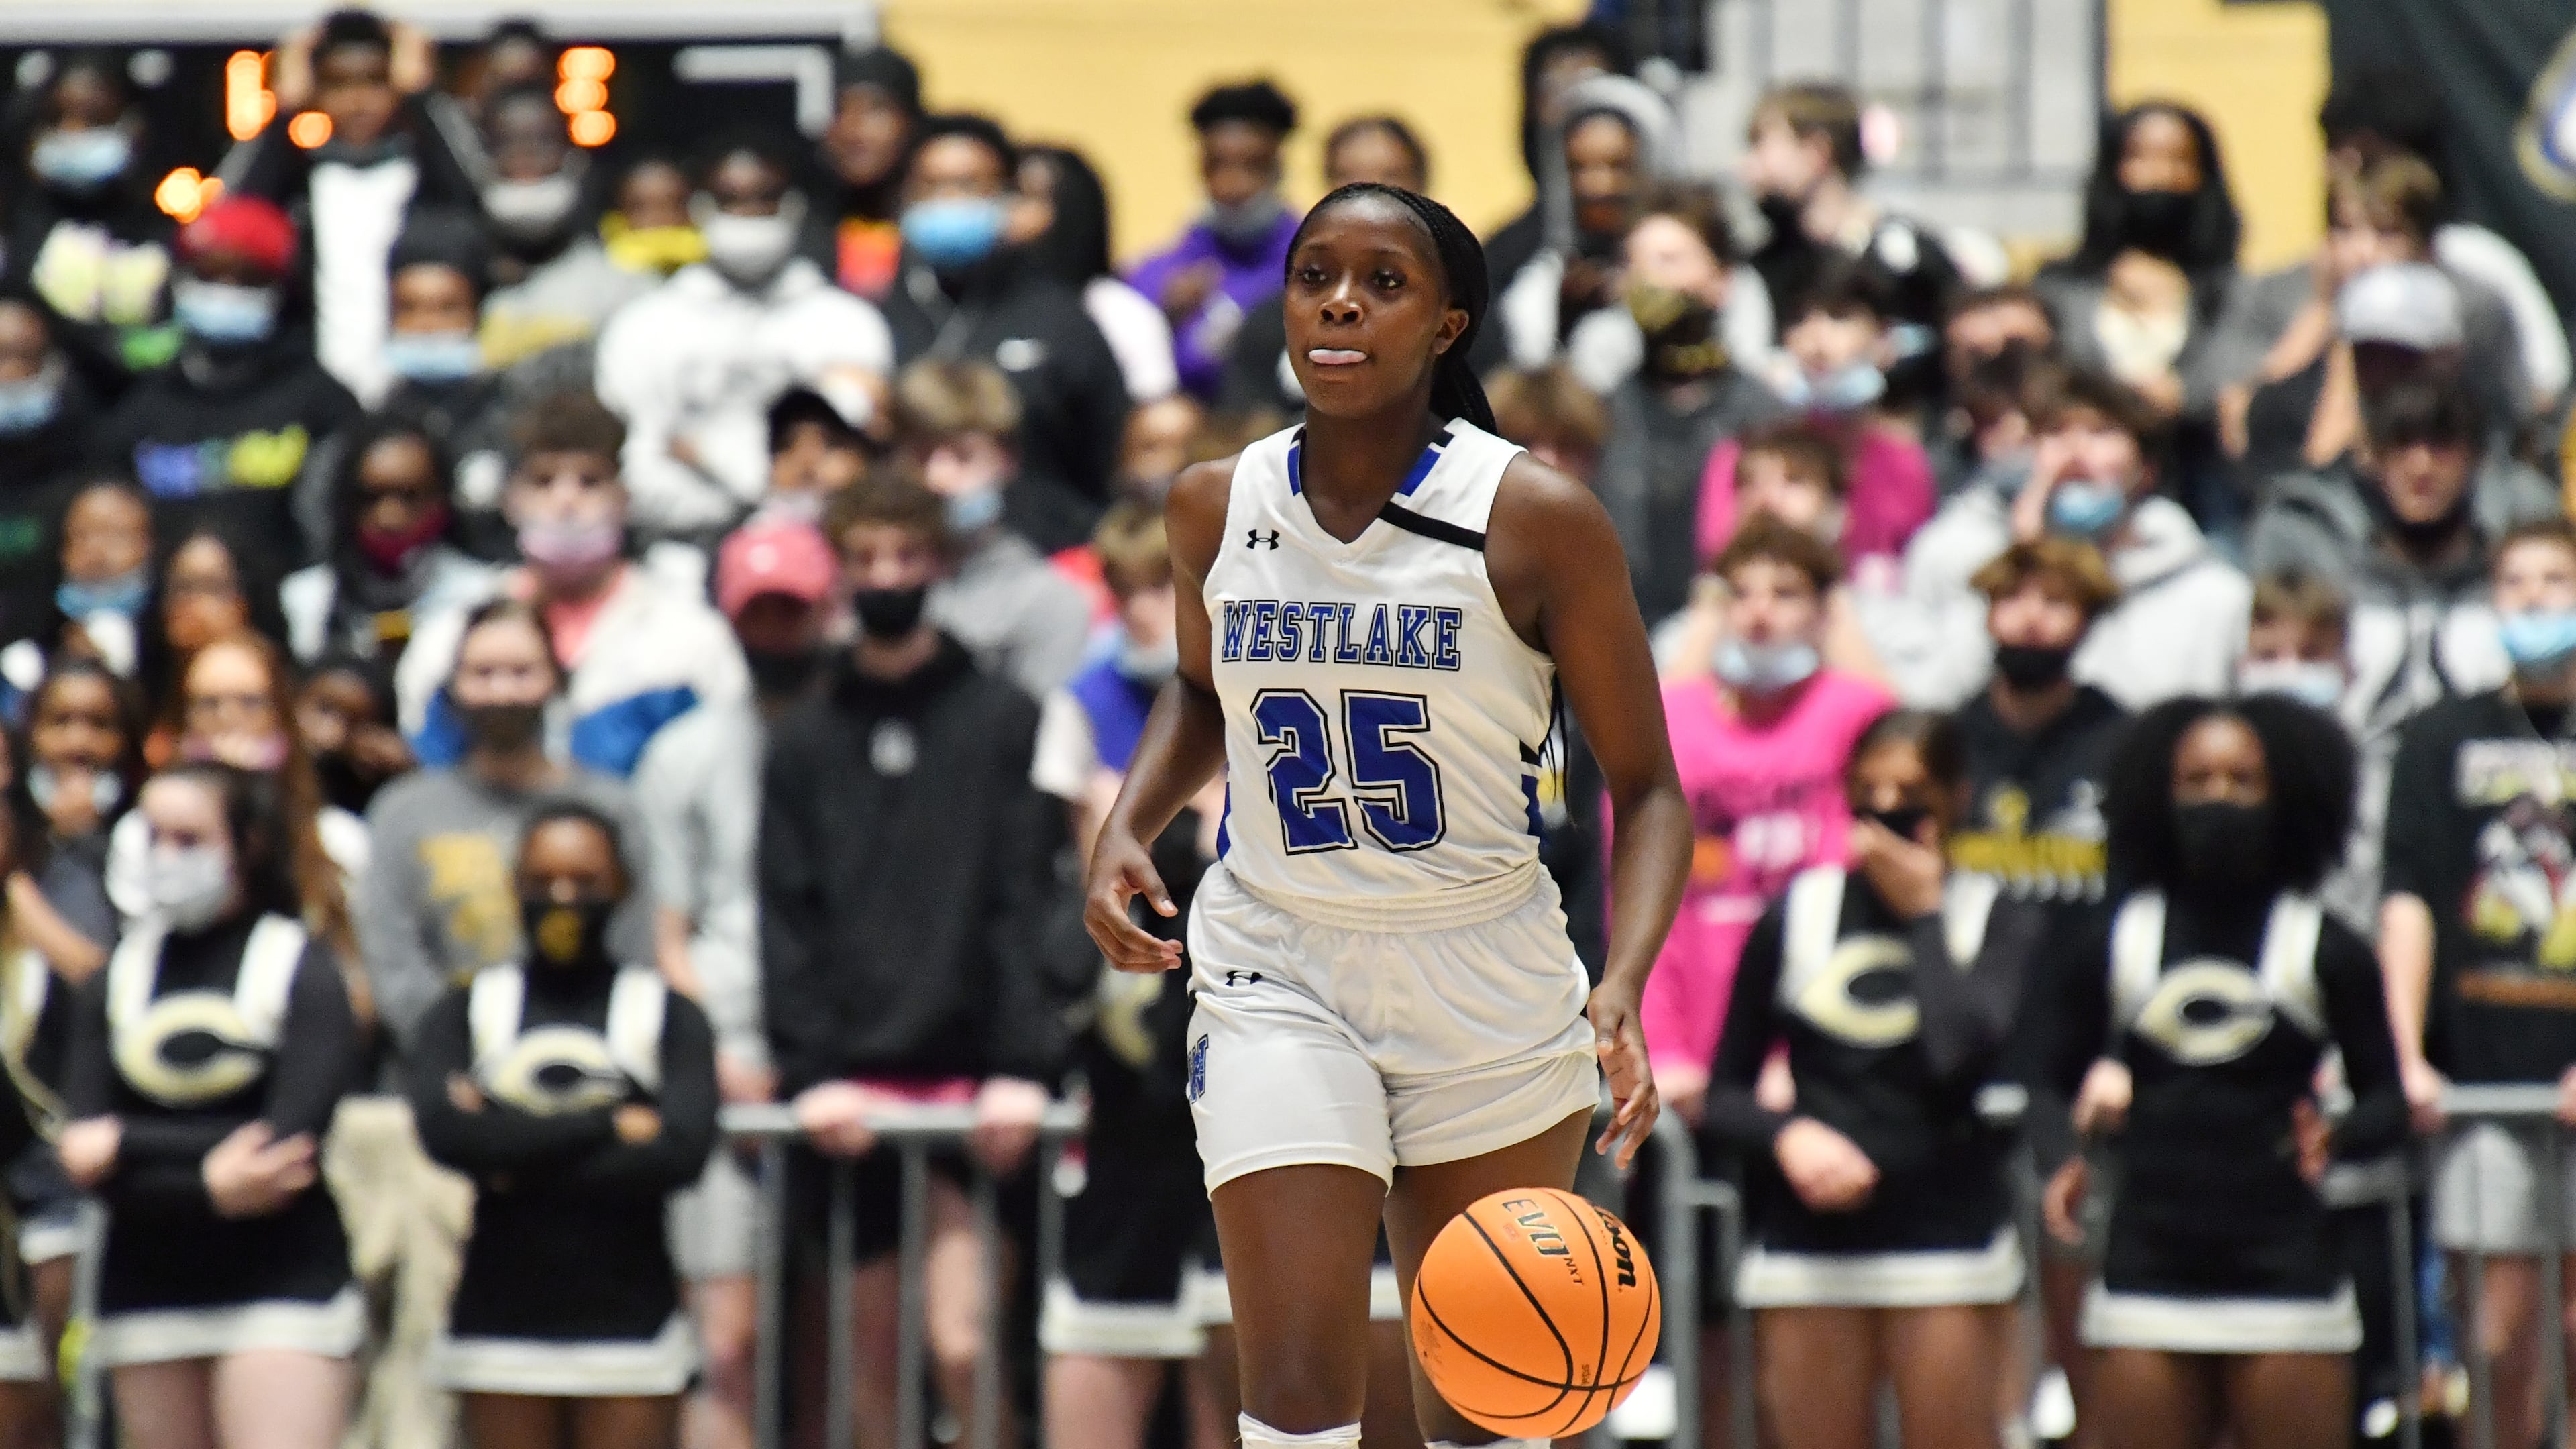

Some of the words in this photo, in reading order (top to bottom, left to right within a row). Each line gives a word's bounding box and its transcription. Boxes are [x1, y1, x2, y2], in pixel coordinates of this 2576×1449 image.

[1222, 600, 1462, 670] WESTLAKE
[1250, 688, 1446, 855] 25
[1501, 1199, 1570, 1256] EVO
[1562, 1257, 1585, 1286] NXT
